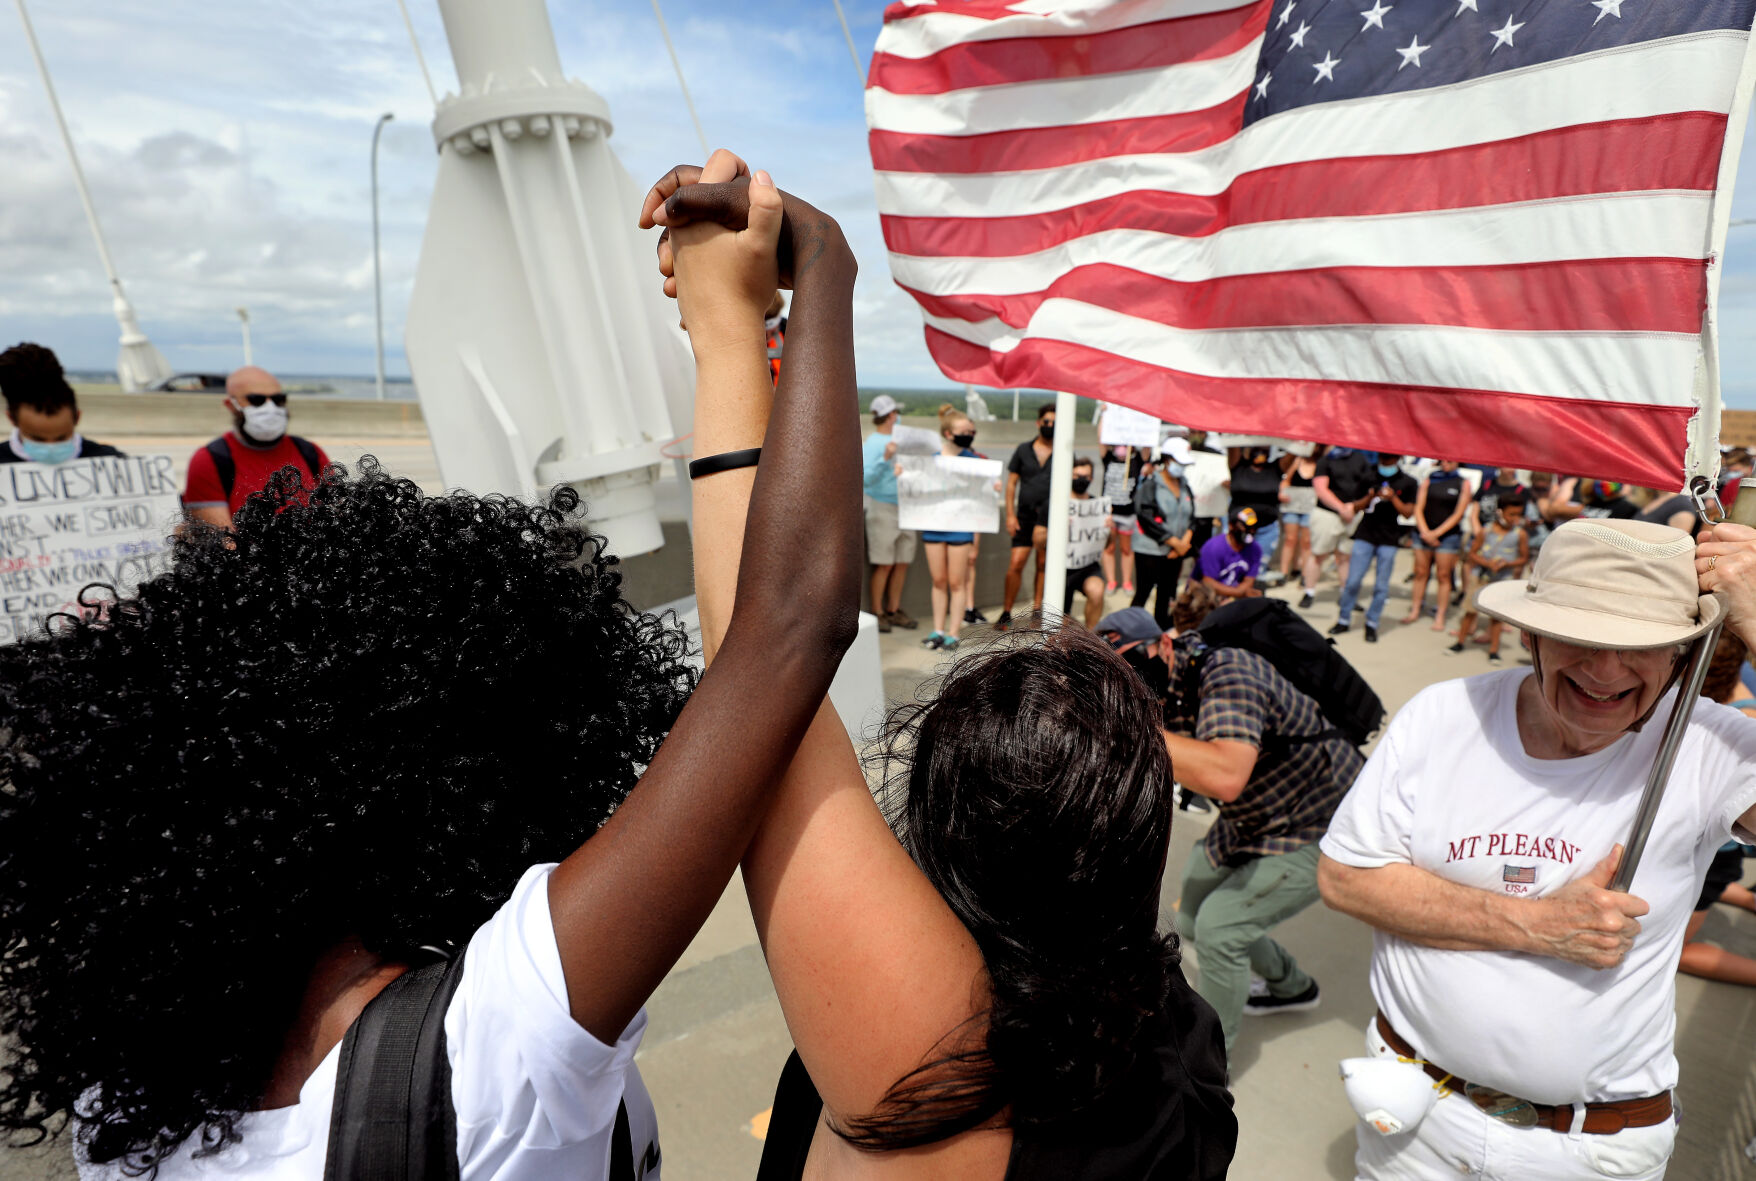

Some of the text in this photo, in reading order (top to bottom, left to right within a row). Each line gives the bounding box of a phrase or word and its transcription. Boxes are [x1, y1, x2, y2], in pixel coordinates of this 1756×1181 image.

[44, 513, 81, 533] WE
[89, 504, 151, 530] STAND
[3, 592, 59, 613] END
[1445, 835, 1481, 863] MT
[1505, 884, 1528, 893] USA
